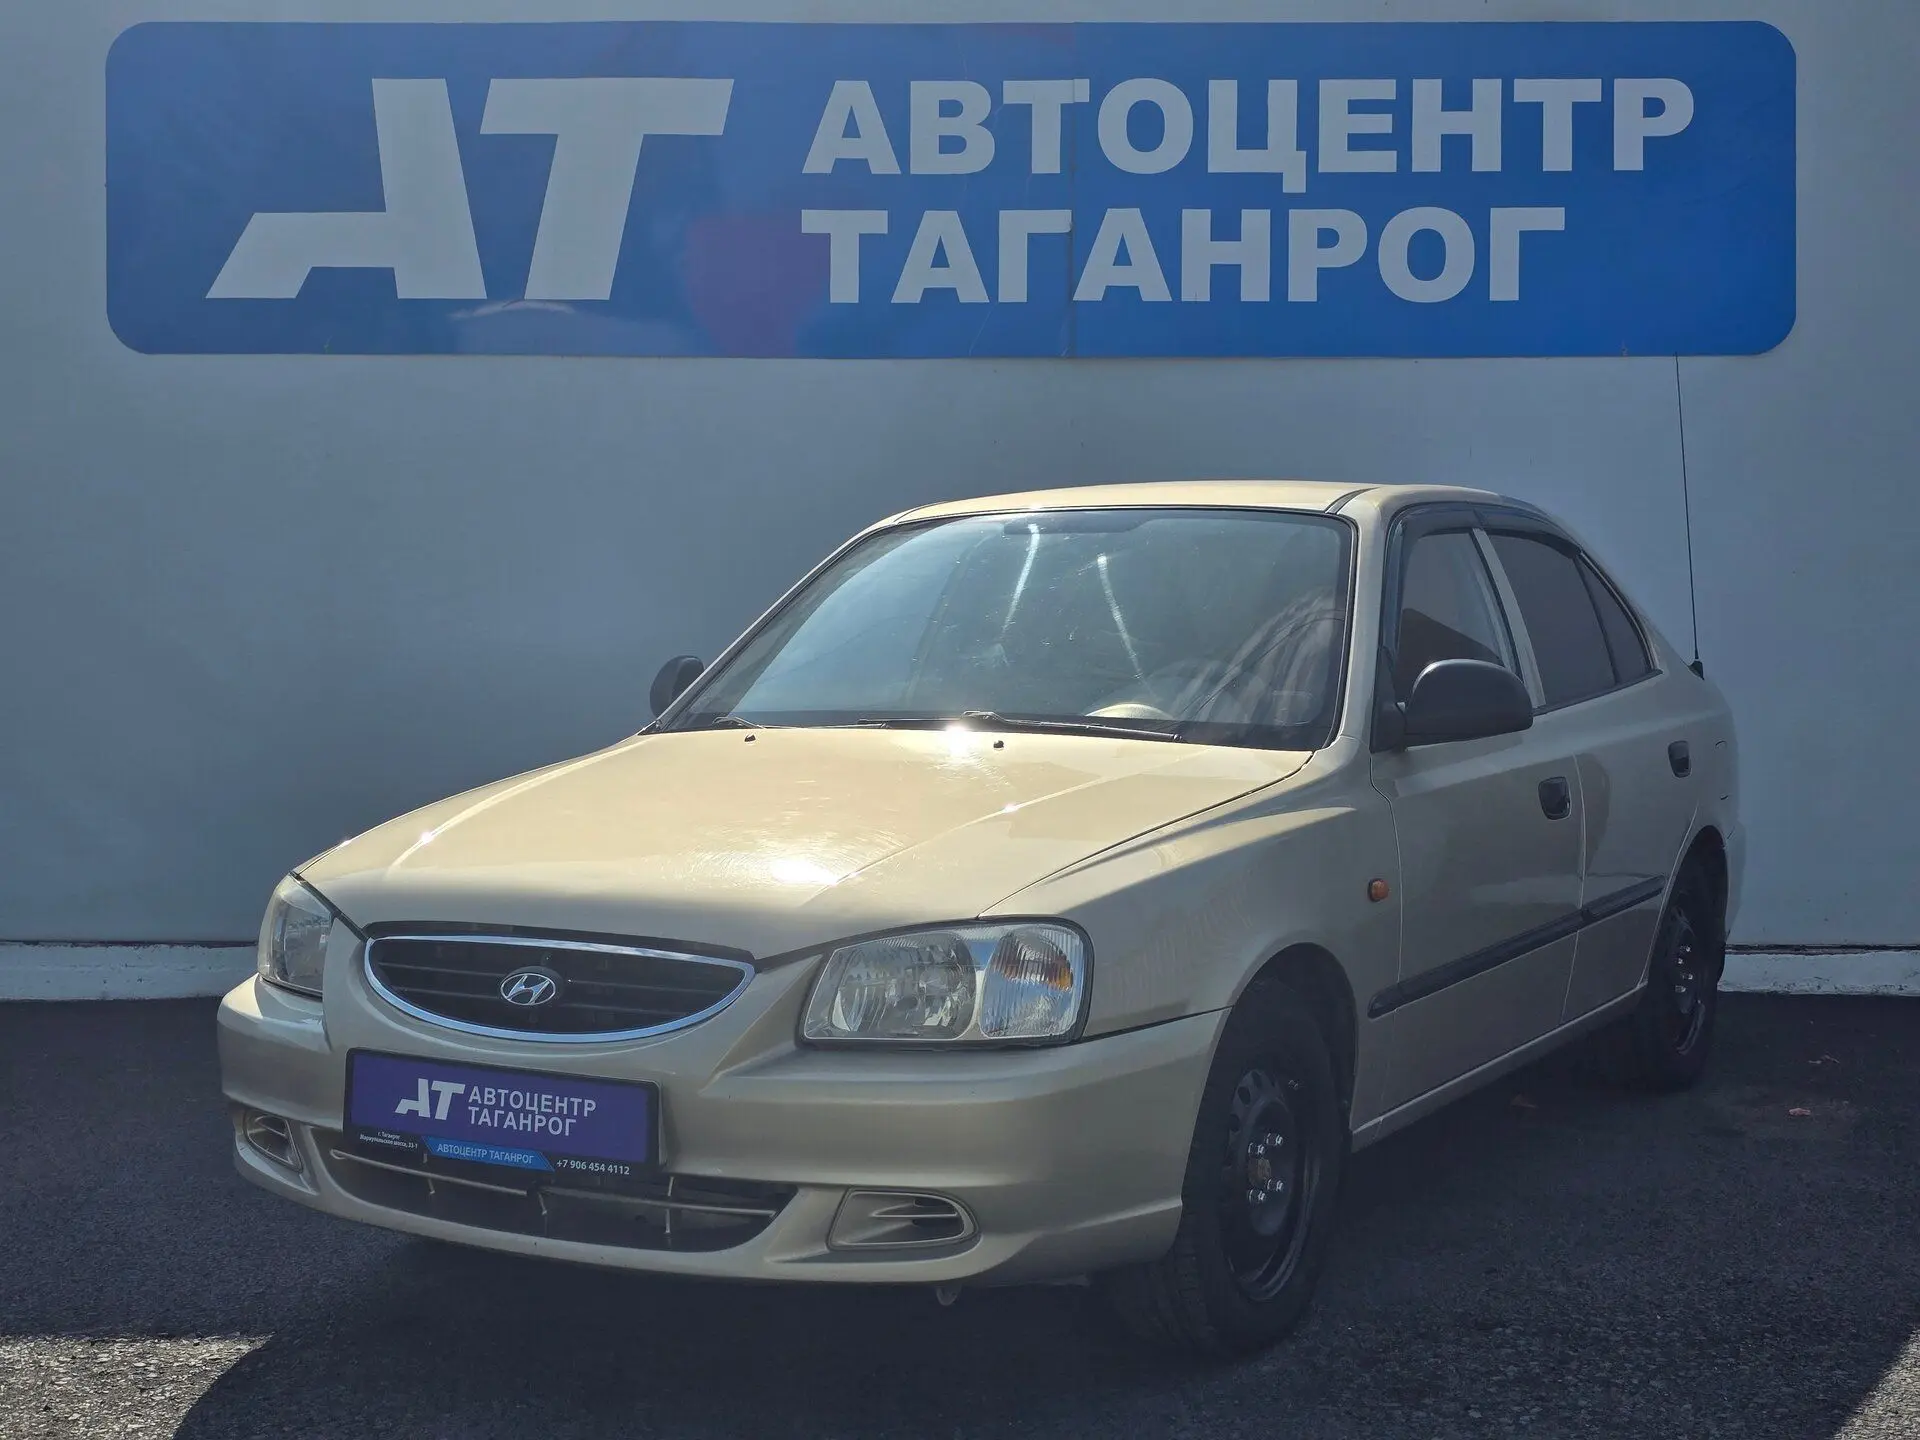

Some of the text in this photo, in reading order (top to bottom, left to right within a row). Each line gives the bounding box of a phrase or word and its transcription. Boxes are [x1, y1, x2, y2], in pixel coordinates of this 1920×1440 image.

[802, 77, 1694, 194] АВТОЦЕНТР
[206, 78, 734, 300] АТ
[801, 206, 1566, 304] ТАГАНРОГ
[395, 1078, 466, 1121] АТ
[468, 1085, 597, 1117] АВТОЦЕНТР
[467, 1106, 577, 1136] ТАГАНРОГ
[437, 1143, 535, 1165] АВТОЦЕНТР ТАГАНРОГ
[556, 1159, 630, 1175] +7 906 454 4112
